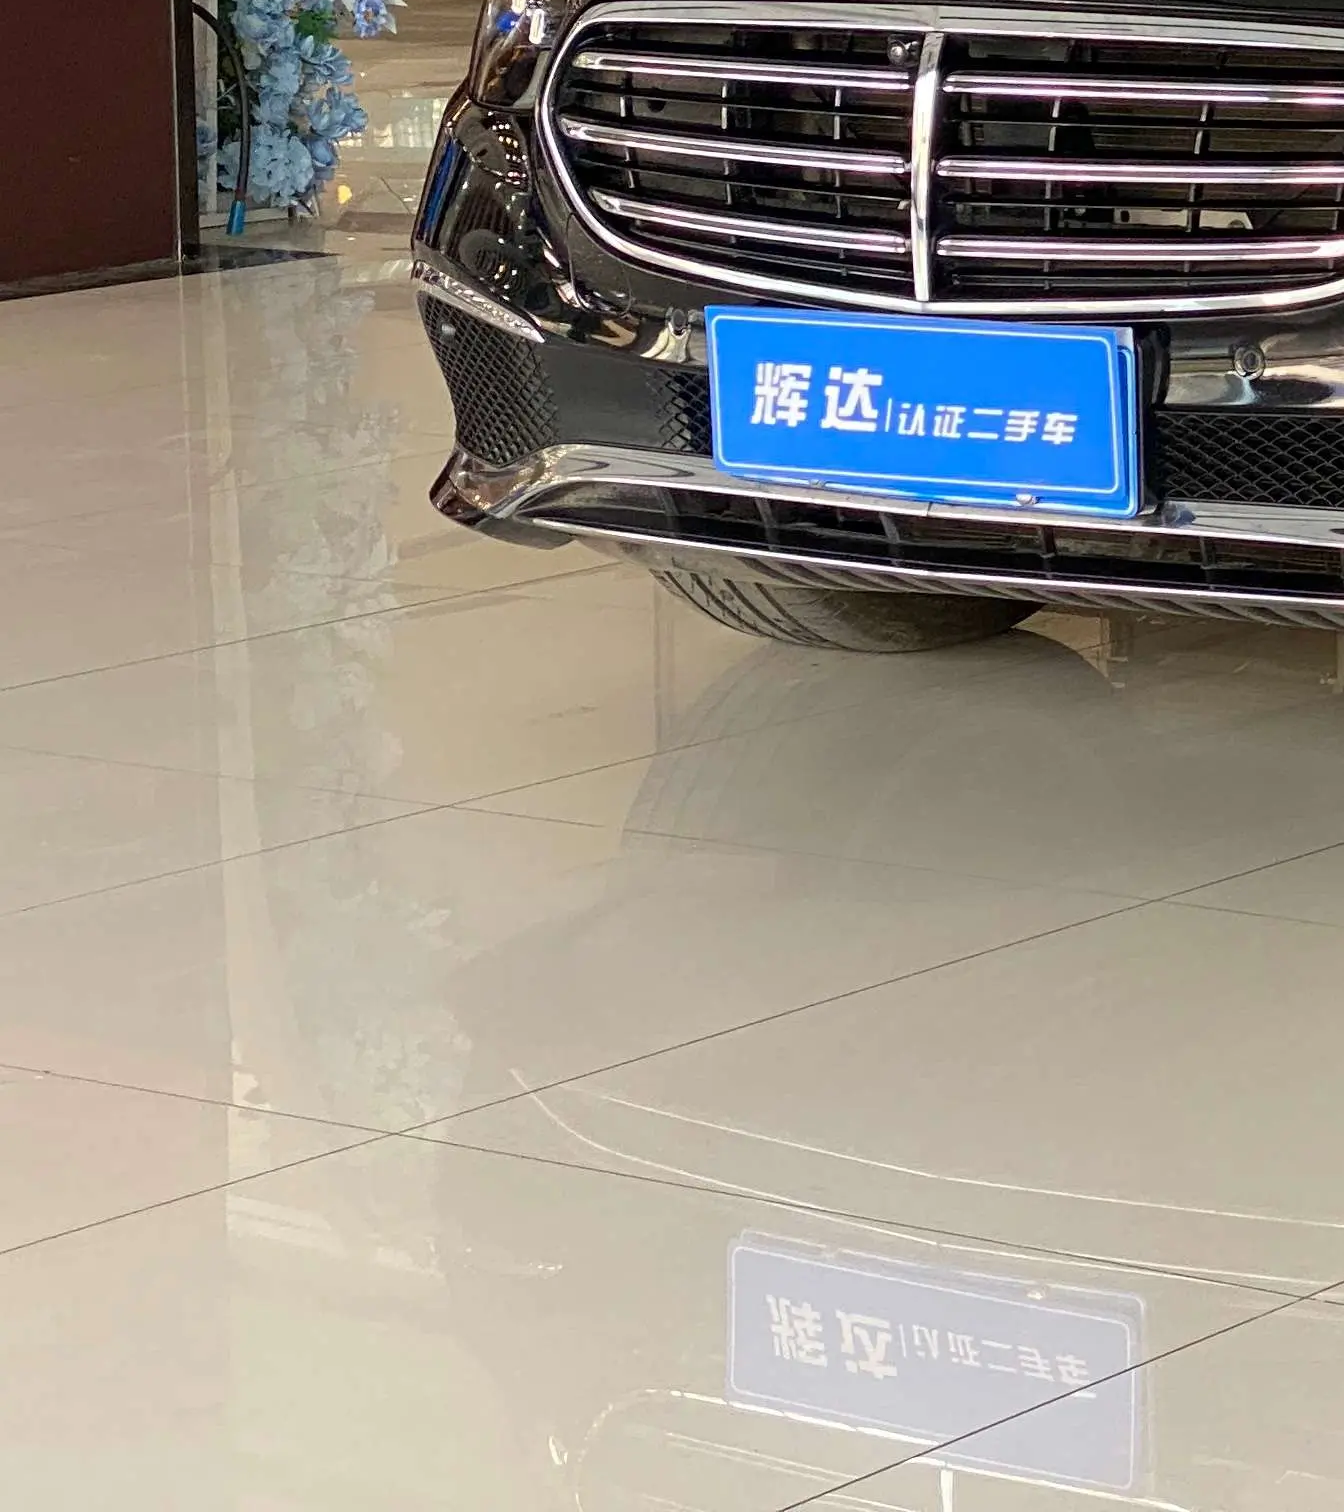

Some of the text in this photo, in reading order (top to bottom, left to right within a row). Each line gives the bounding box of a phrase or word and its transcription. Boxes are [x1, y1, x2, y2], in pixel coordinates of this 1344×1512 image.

[750, 360, 1079, 446] 辉达 认证二手车
